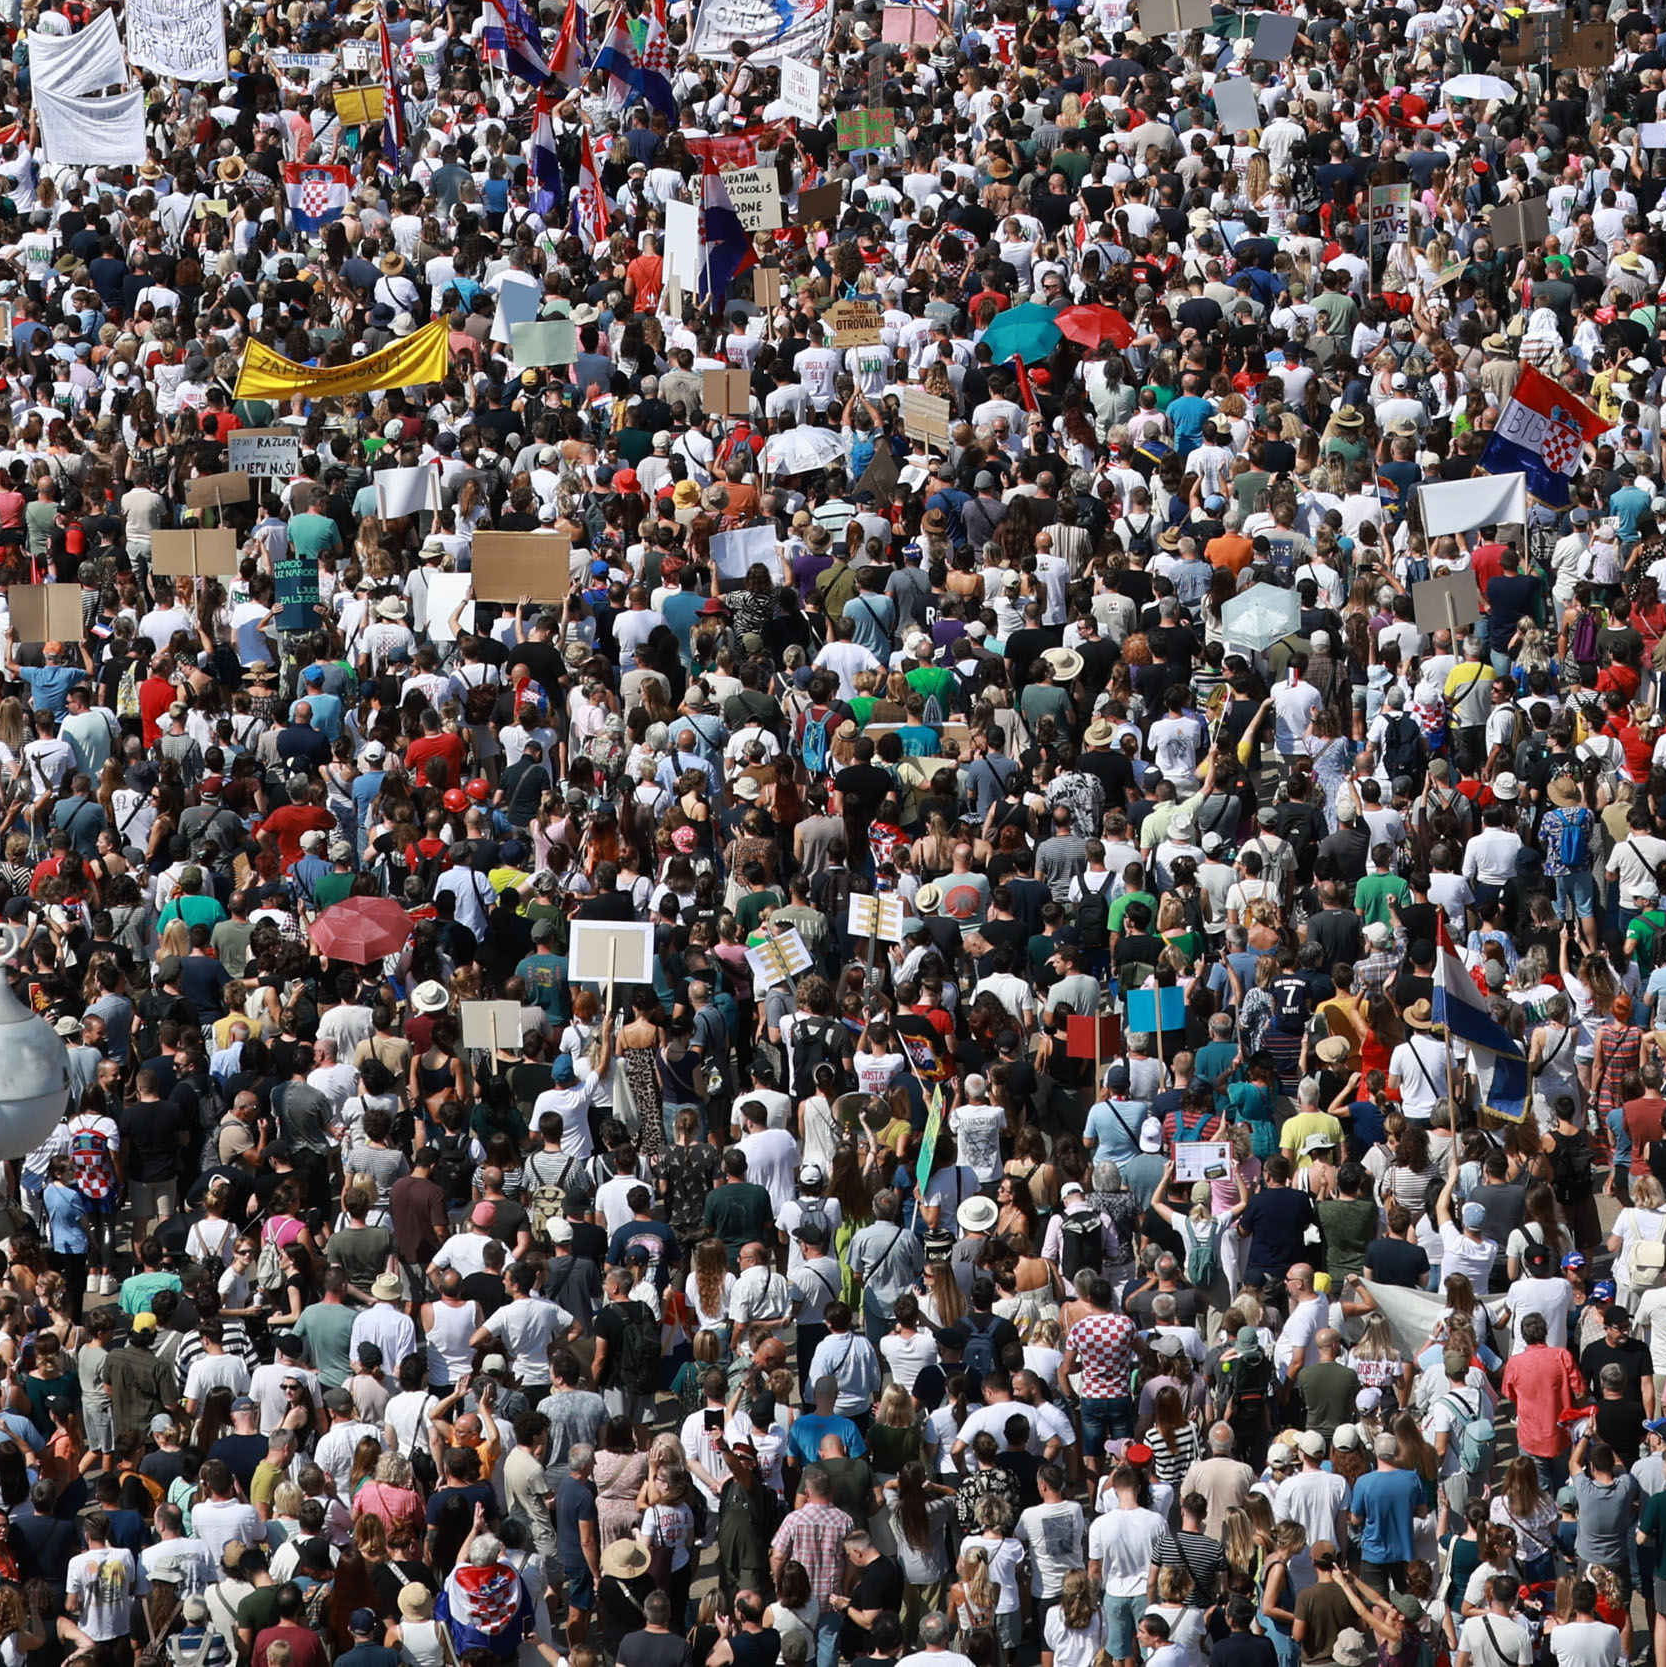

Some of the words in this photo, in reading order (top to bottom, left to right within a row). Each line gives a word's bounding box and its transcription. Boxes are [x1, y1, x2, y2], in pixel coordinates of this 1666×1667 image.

[737, 181, 773, 196] OKOLIŠ
[853, 300, 869, 310] ŠTO
[836, 316, 885, 331] OTROVALI!!!
[262, 437, 302, 450] RAZLOGA
[275, 460, 301, 476] NAŠU
[274, 560, 303, 570] NAROD
[275, 570, 284, 579] UZ
[280, 596, 290, 605] ZA
[1283, 986, 1296, 1007] 7
[862, 1070, 885, 1080] DOSTA
[1358, 1363, 1381, 1375] DOSTA
